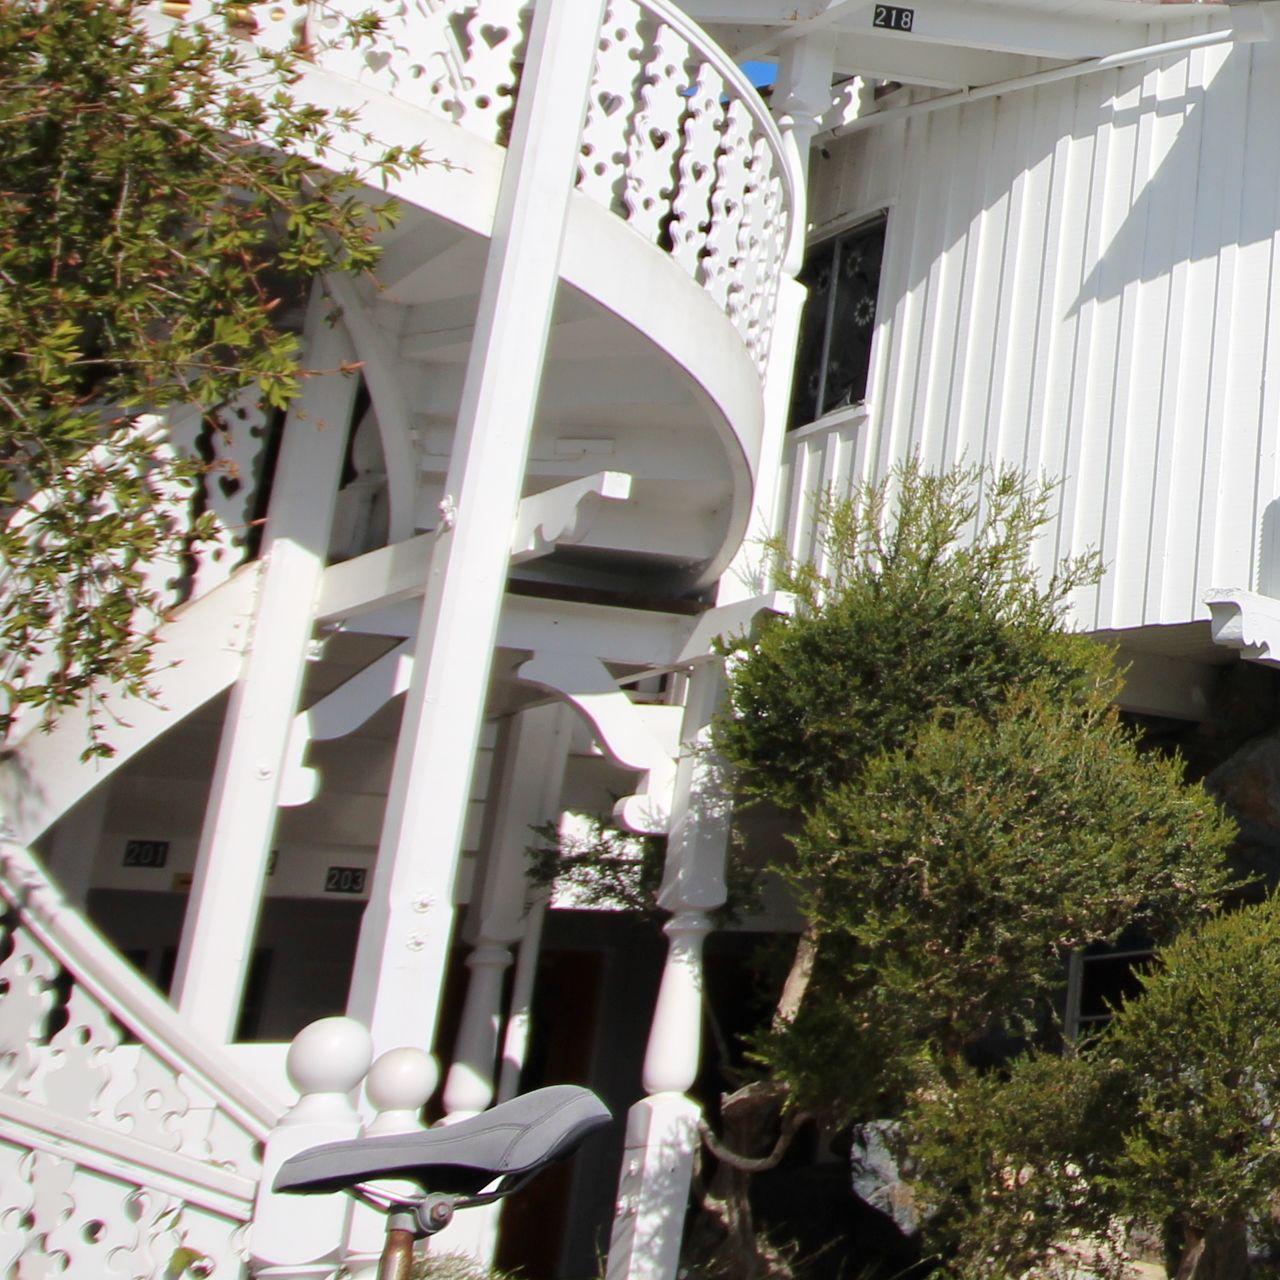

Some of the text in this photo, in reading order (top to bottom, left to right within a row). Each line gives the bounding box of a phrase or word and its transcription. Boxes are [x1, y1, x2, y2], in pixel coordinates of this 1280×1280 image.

[874, 7, 912, 29] 218
[126, 844, 165, 865] 201
[327, 870, 364, 890] 203
